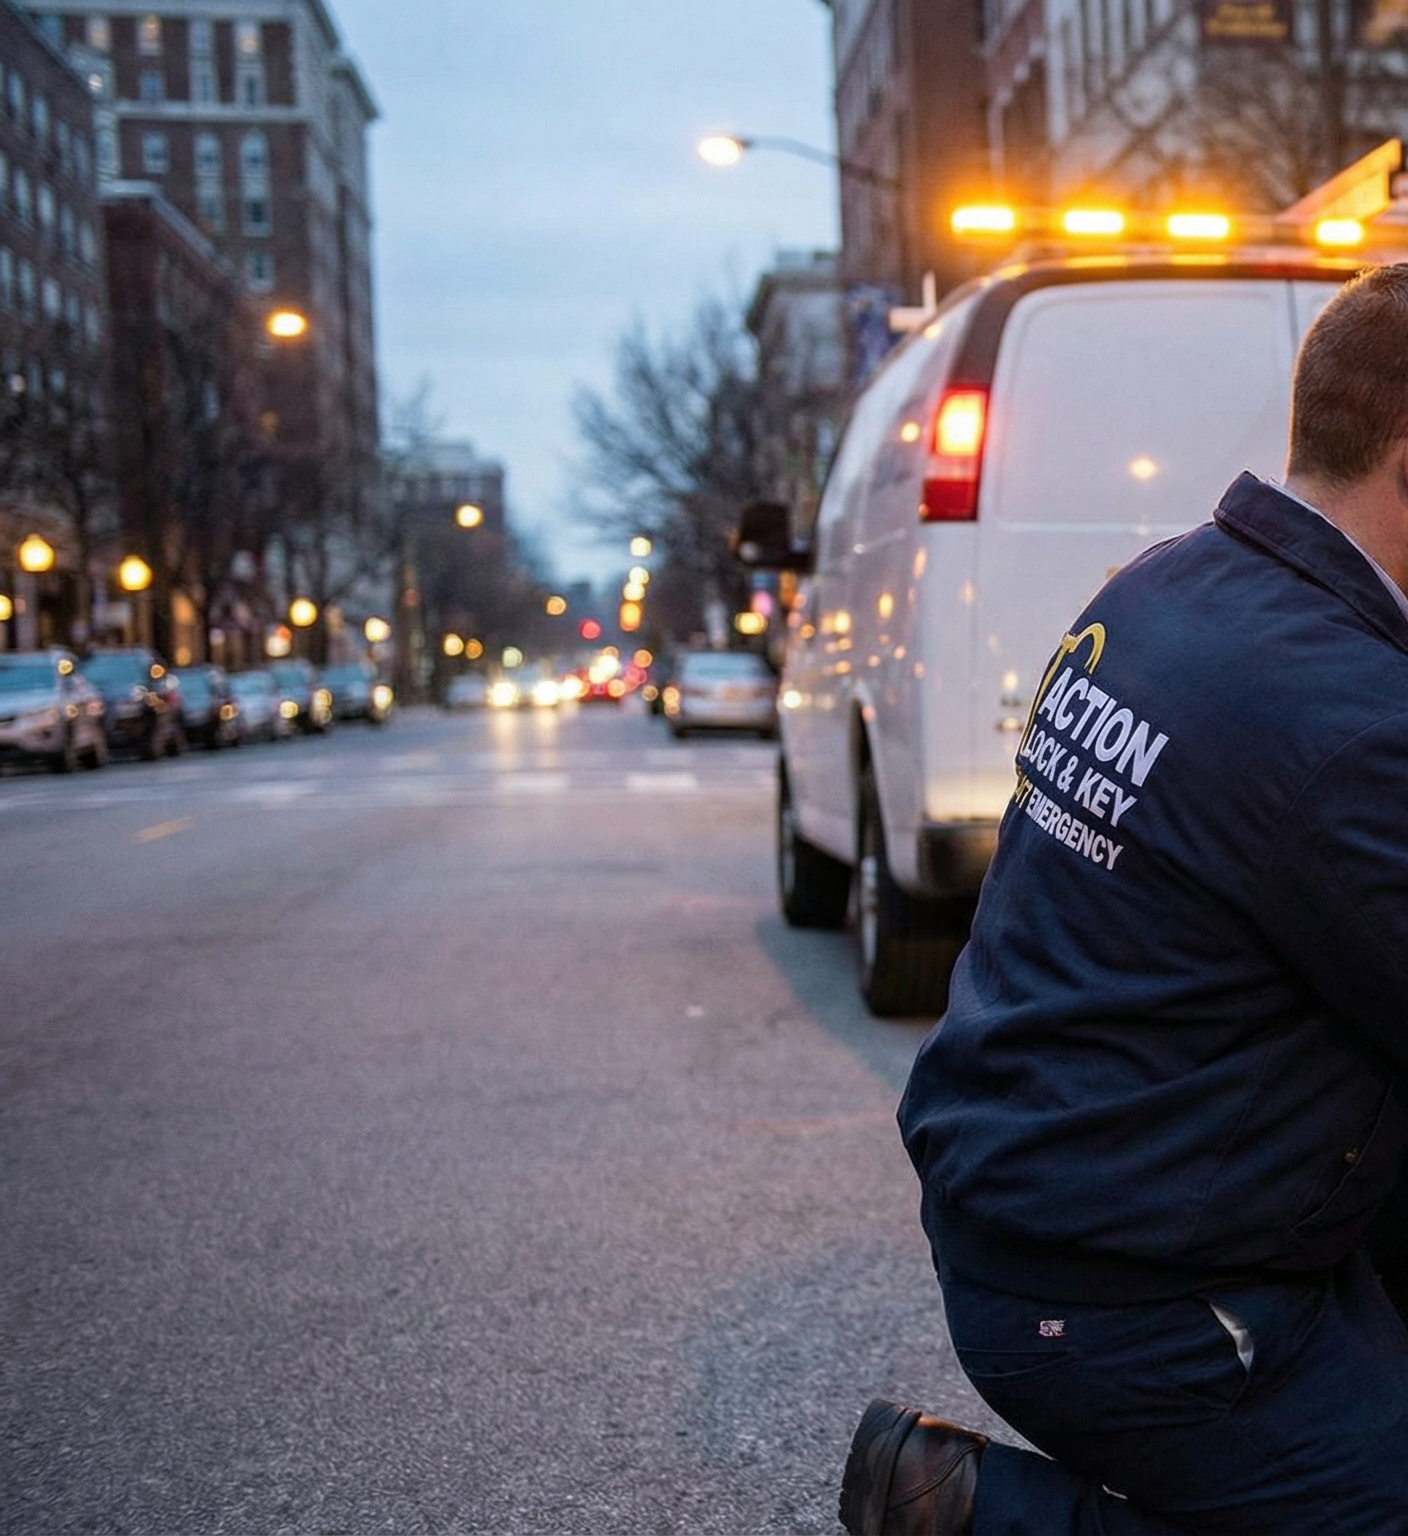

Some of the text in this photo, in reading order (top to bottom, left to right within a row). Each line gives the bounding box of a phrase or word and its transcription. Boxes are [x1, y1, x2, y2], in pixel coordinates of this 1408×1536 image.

[1020, 723, 1138, 828] LOCK & KEY
[1038, 666, 1169, 788] ACTION
[1026, 786, 1124, 871] EMERGENCY
